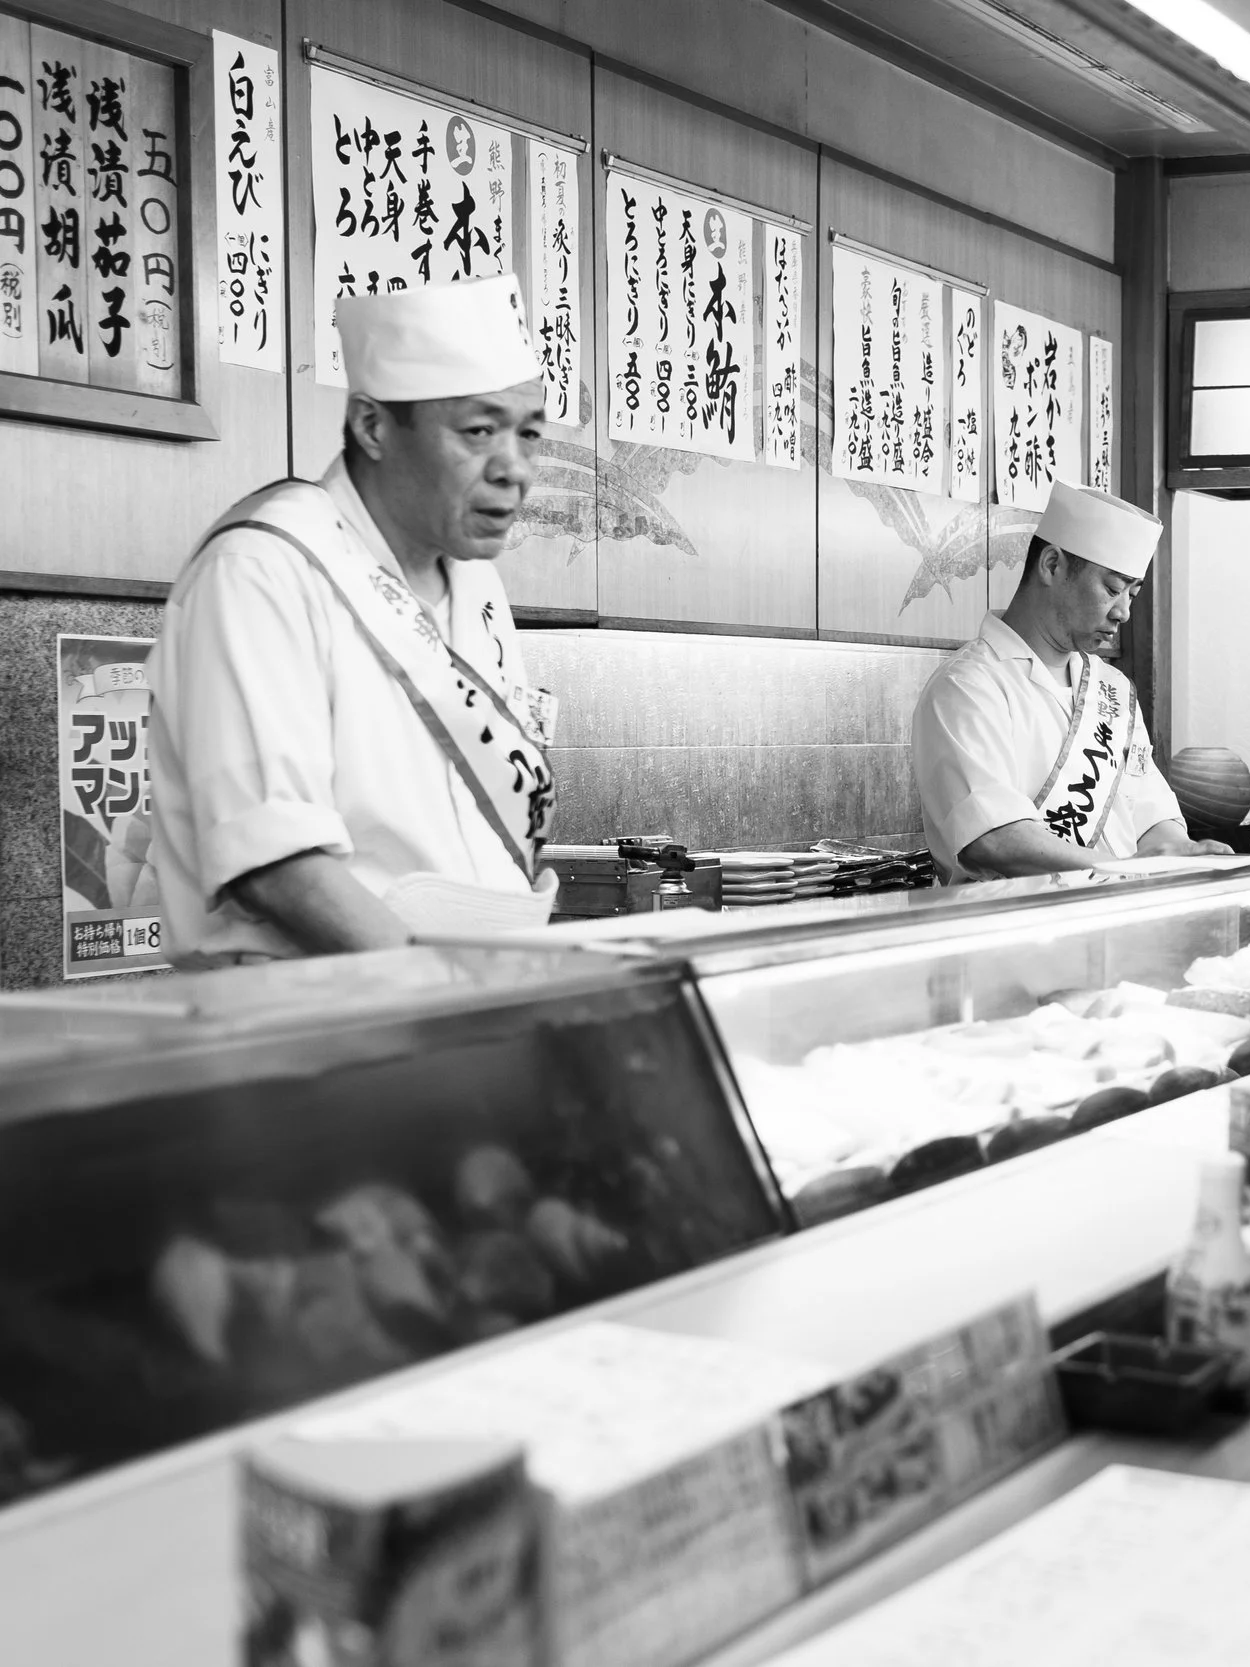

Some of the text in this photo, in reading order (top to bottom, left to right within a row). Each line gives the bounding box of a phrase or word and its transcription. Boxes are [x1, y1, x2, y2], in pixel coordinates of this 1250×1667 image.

[228, 51, 263, 215] 白えび
[444, 180, 490, 282] 本
[487, 138, 512, 275] 熊野まぐ
[250, 231, 272, 351] にぎり
[71, 714, 151, 763] アッ
[71, 768, 151, 816] マン
[74, 922, 123, 941] お持ち帰り
[76, 938, 121, 958] 特別価格
